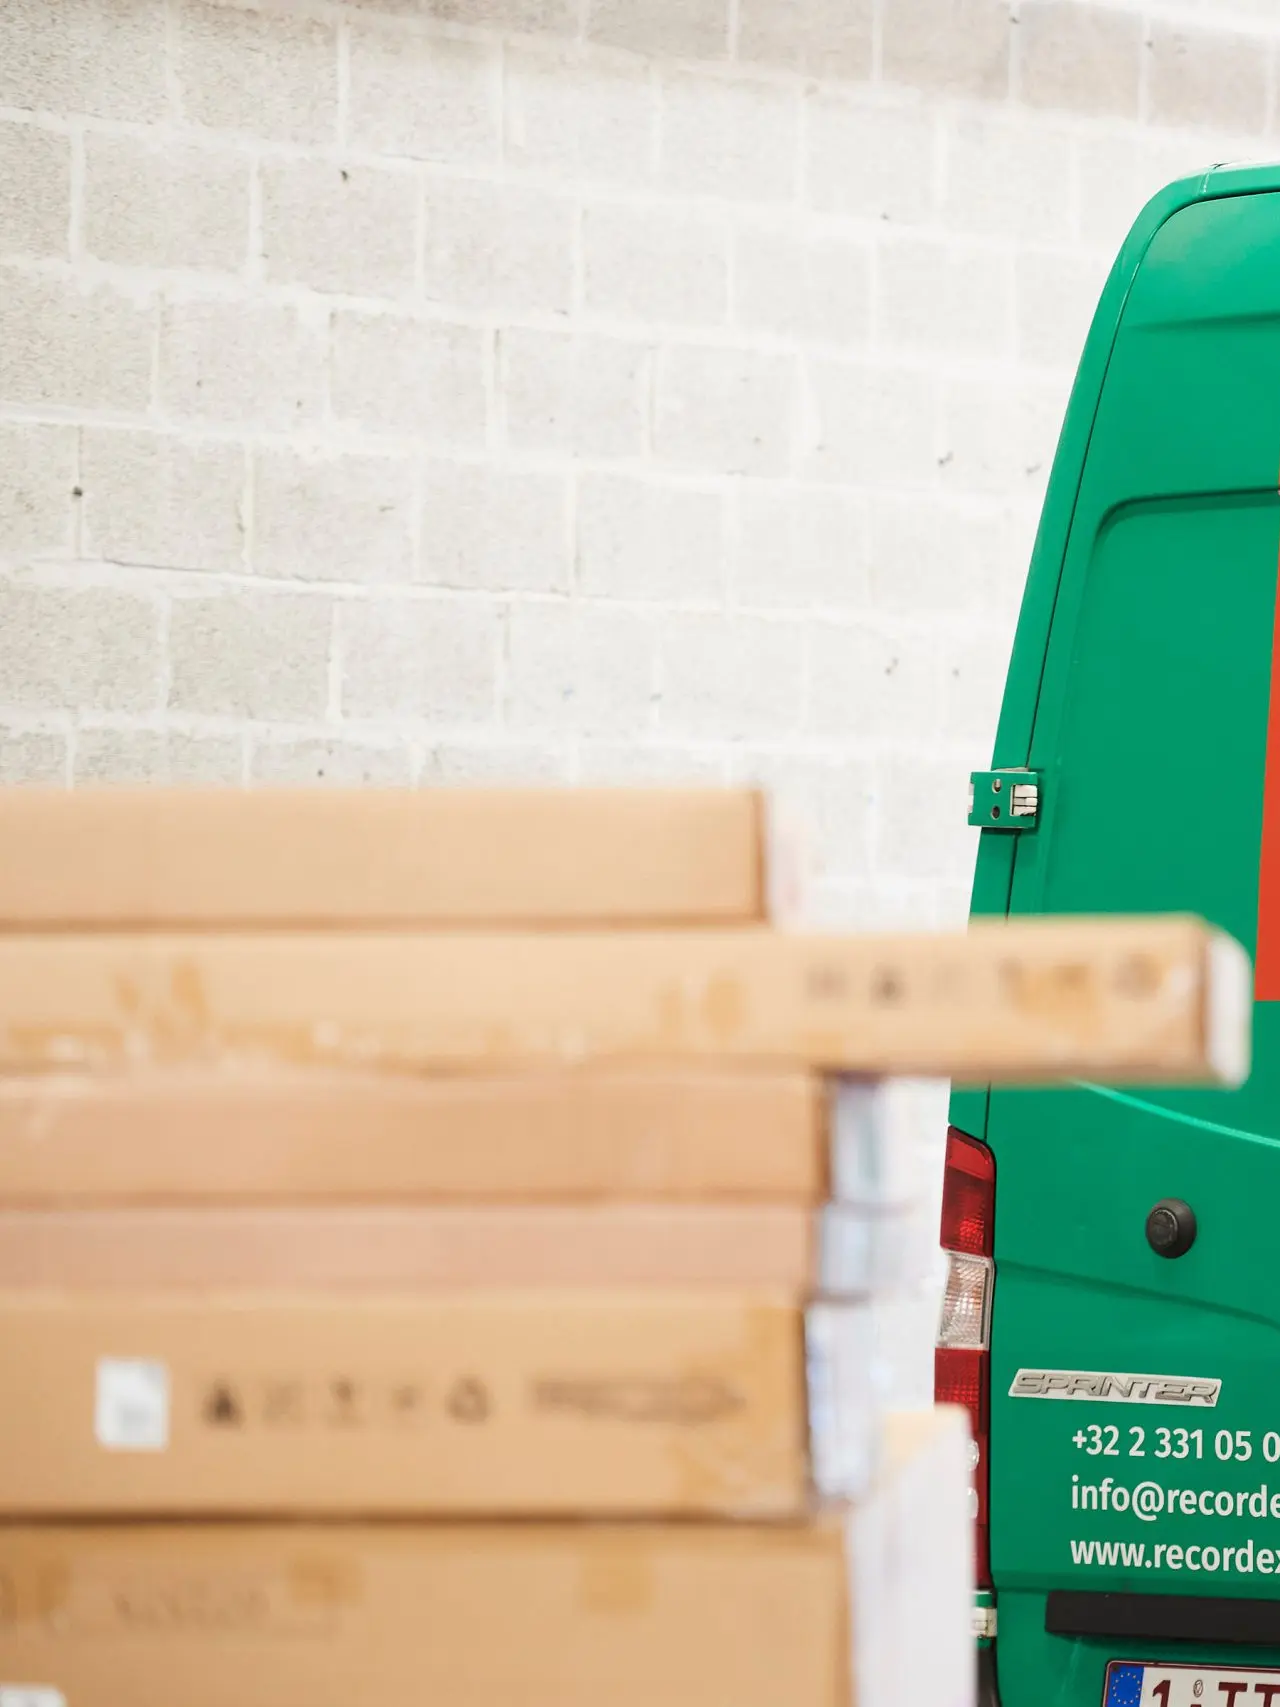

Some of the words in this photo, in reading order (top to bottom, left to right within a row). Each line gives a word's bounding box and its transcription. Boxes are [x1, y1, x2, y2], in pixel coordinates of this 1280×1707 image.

[1012, 1372, 1218, 1404] SPRINTER
[1072, 1424, 1120, 1456] +32
[1128, 1426, 1146, 1457] 2
[1154, 1427, 1203, 1459] 331
[1214, 1429, 1252, 1462] 05
